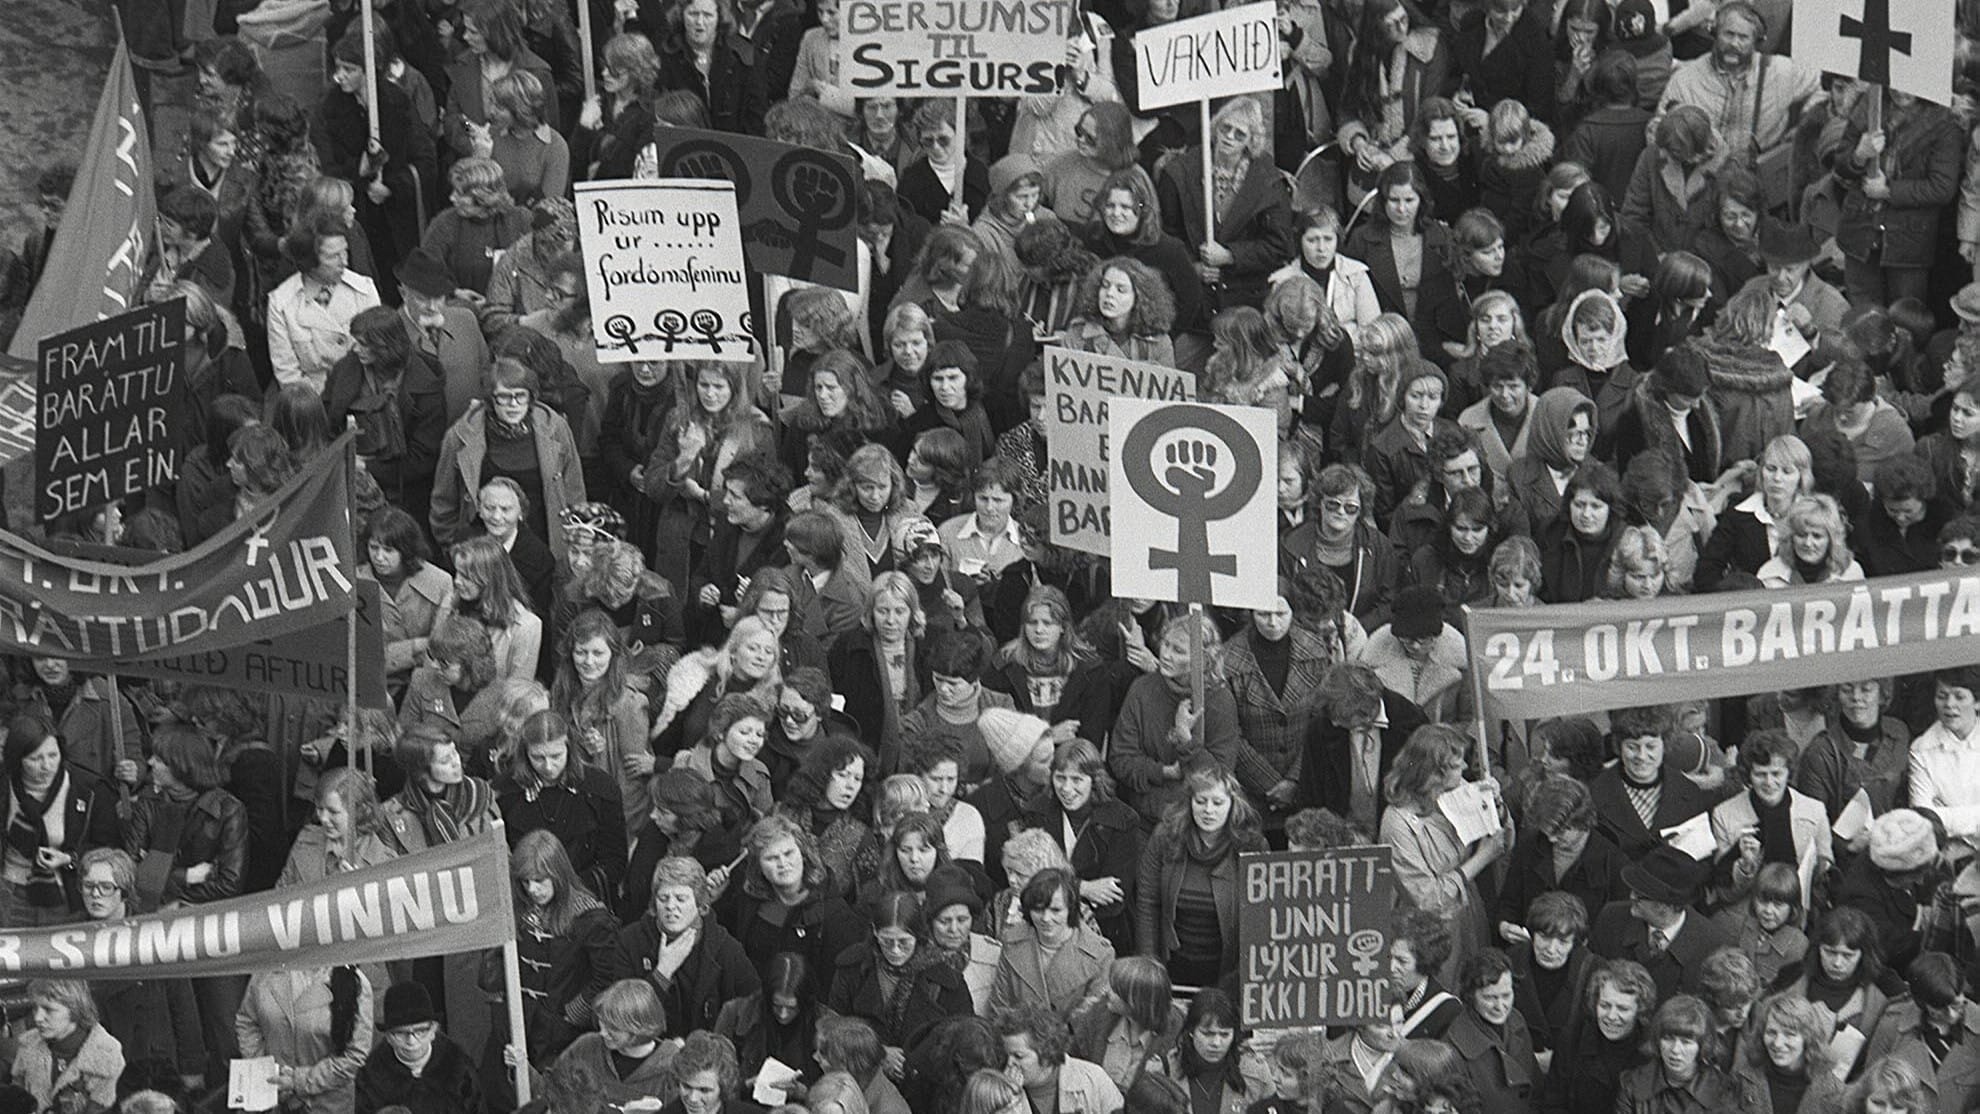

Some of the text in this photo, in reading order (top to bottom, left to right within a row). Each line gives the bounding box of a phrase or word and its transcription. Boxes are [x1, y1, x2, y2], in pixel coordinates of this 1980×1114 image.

[848, 1, 1069, 36] BERJUMST
[850, 43, 1066, 95] SIGURS!
[927, 33, 987, 58] TIL
[1144, 18, 1280, 87] VAKNIÐ!
[677, 211, 721, 237] upp
[46, 332, 126, 385] FRAM
[1051, 354, 1196, 401] KVENNA-
[50, 407, 167, 472] ALLAR
[43, 467, 110, 520] SEM
[1484, 628, 1575, 690] 24.
[1583, 614, 1709, 682] OKT.
[1247, 852, 1391, 903] BARÁTT-
[267, 866, 479, 951] VINNU
[1243, 981, 1307, 1025] EKKI
[1336, 978, 1391, 1019] DAG
